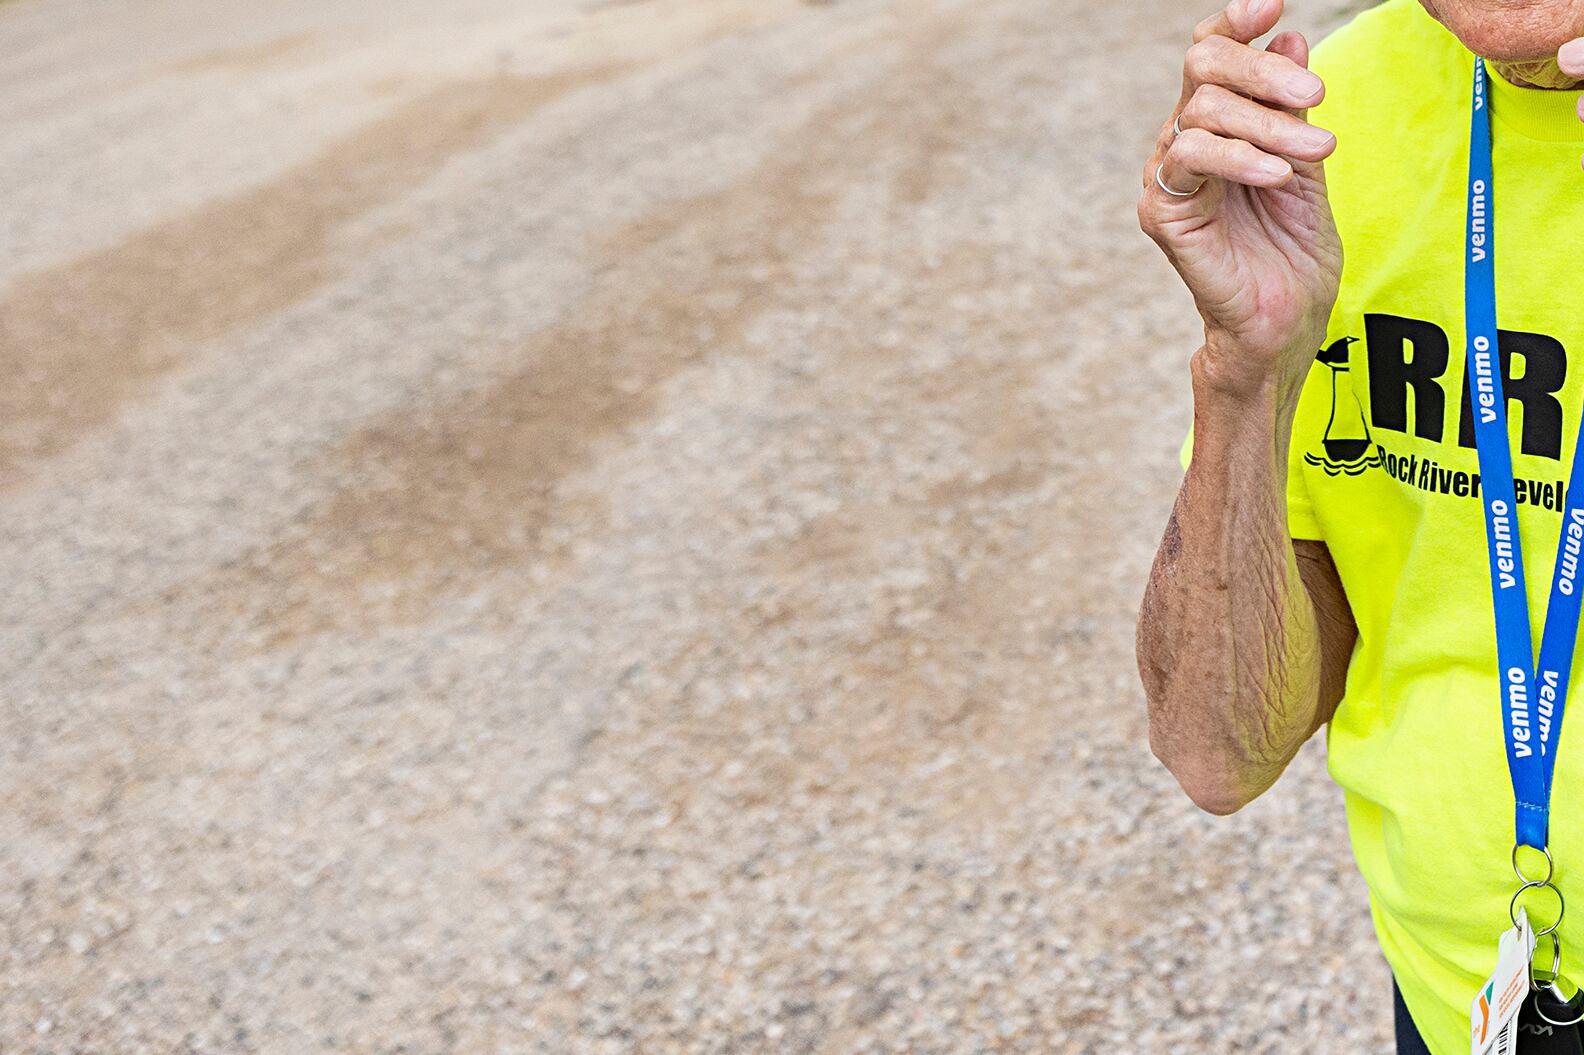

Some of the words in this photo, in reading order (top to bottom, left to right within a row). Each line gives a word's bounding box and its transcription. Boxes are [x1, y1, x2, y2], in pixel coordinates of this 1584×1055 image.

[1474, 55, 1484, 111] ven
[1472, 179, 1485, 262] venmo
[1473, 335, 1496, 423] venmo
[1377, 444, 1416, 487] Rock
[1418, 458, 1481, 498] River
[1491, 500, 1516, 589] venmo
[1508, 667, 1533, 759] venmo
